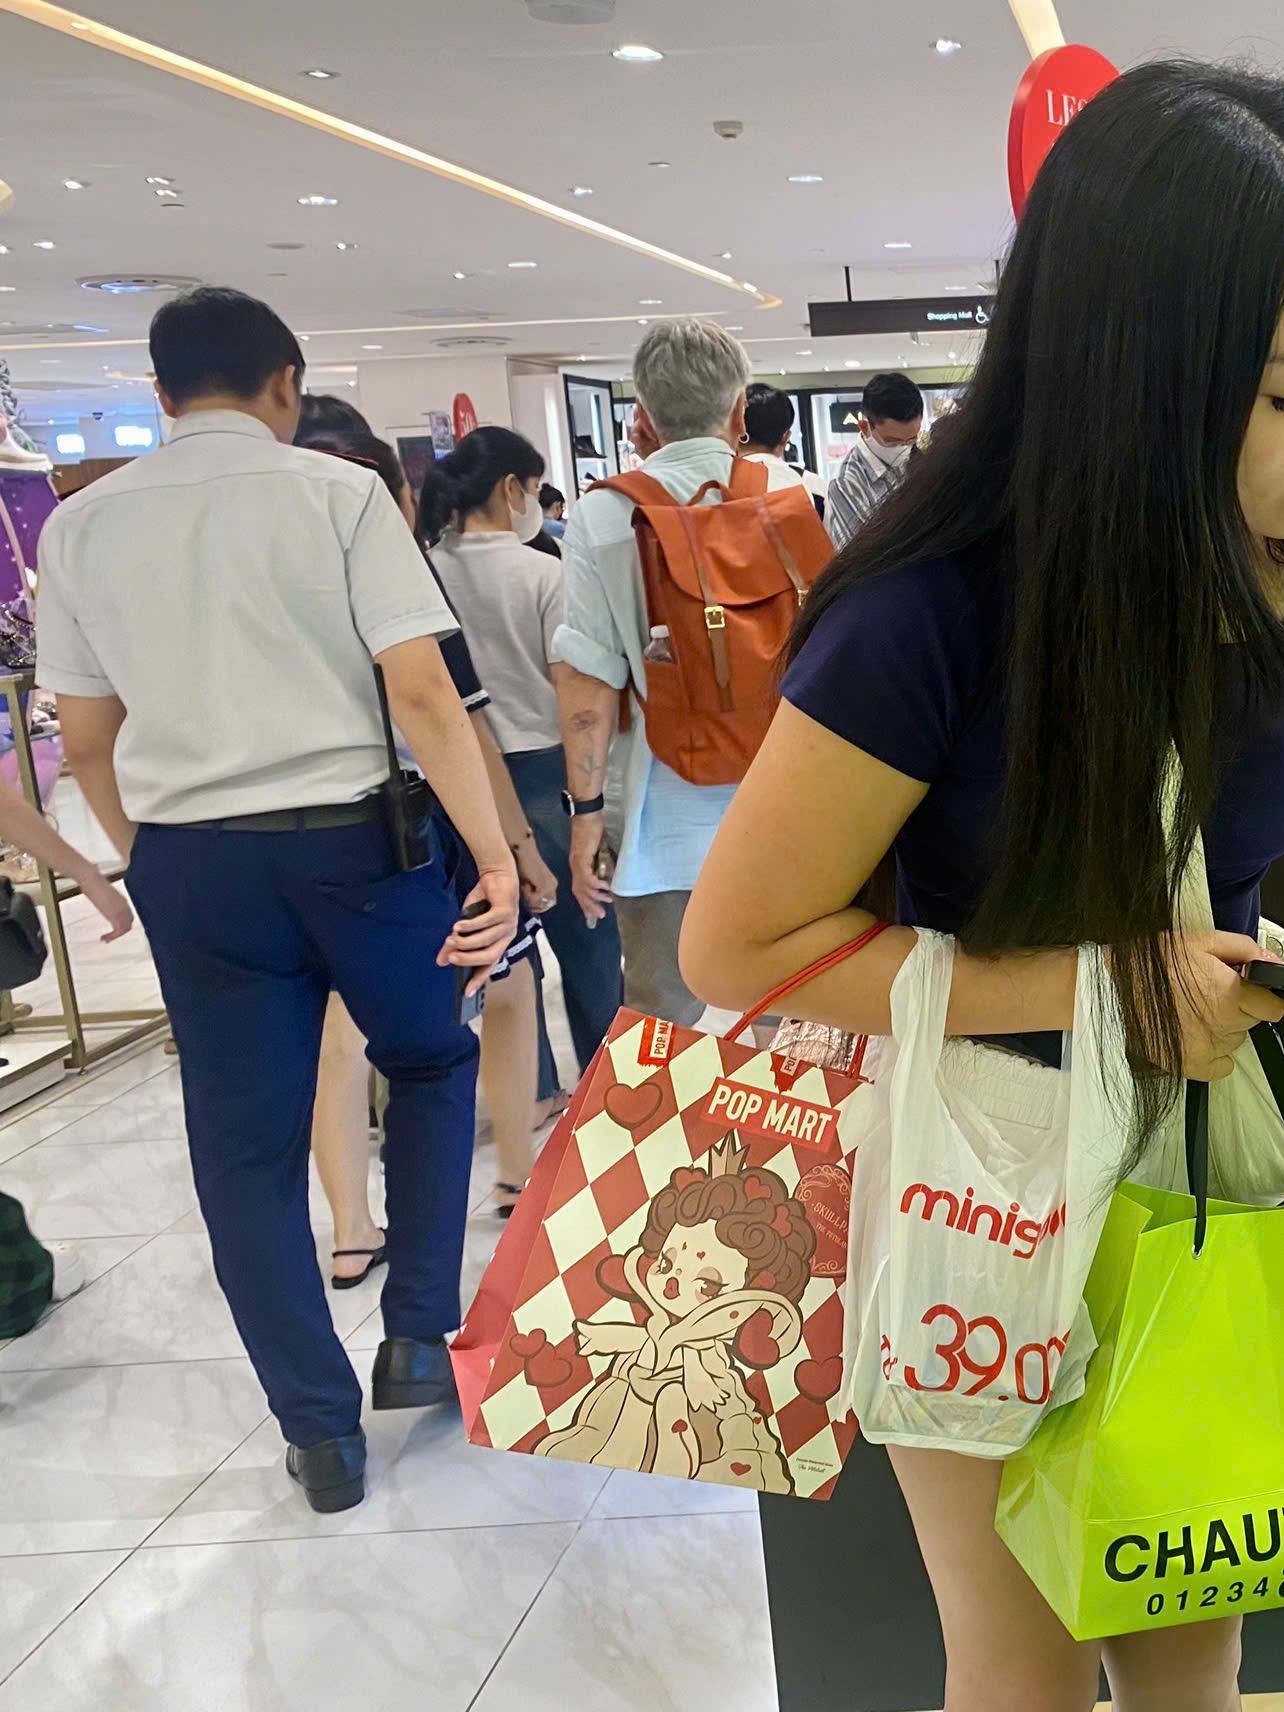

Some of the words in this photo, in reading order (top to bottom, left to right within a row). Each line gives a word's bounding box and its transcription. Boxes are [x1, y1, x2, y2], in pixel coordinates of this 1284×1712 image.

[654, 1036, 667, 1055] POP
[707, 1083, 763, 1124] POP
[761, 1099, 833, 1144] MART
